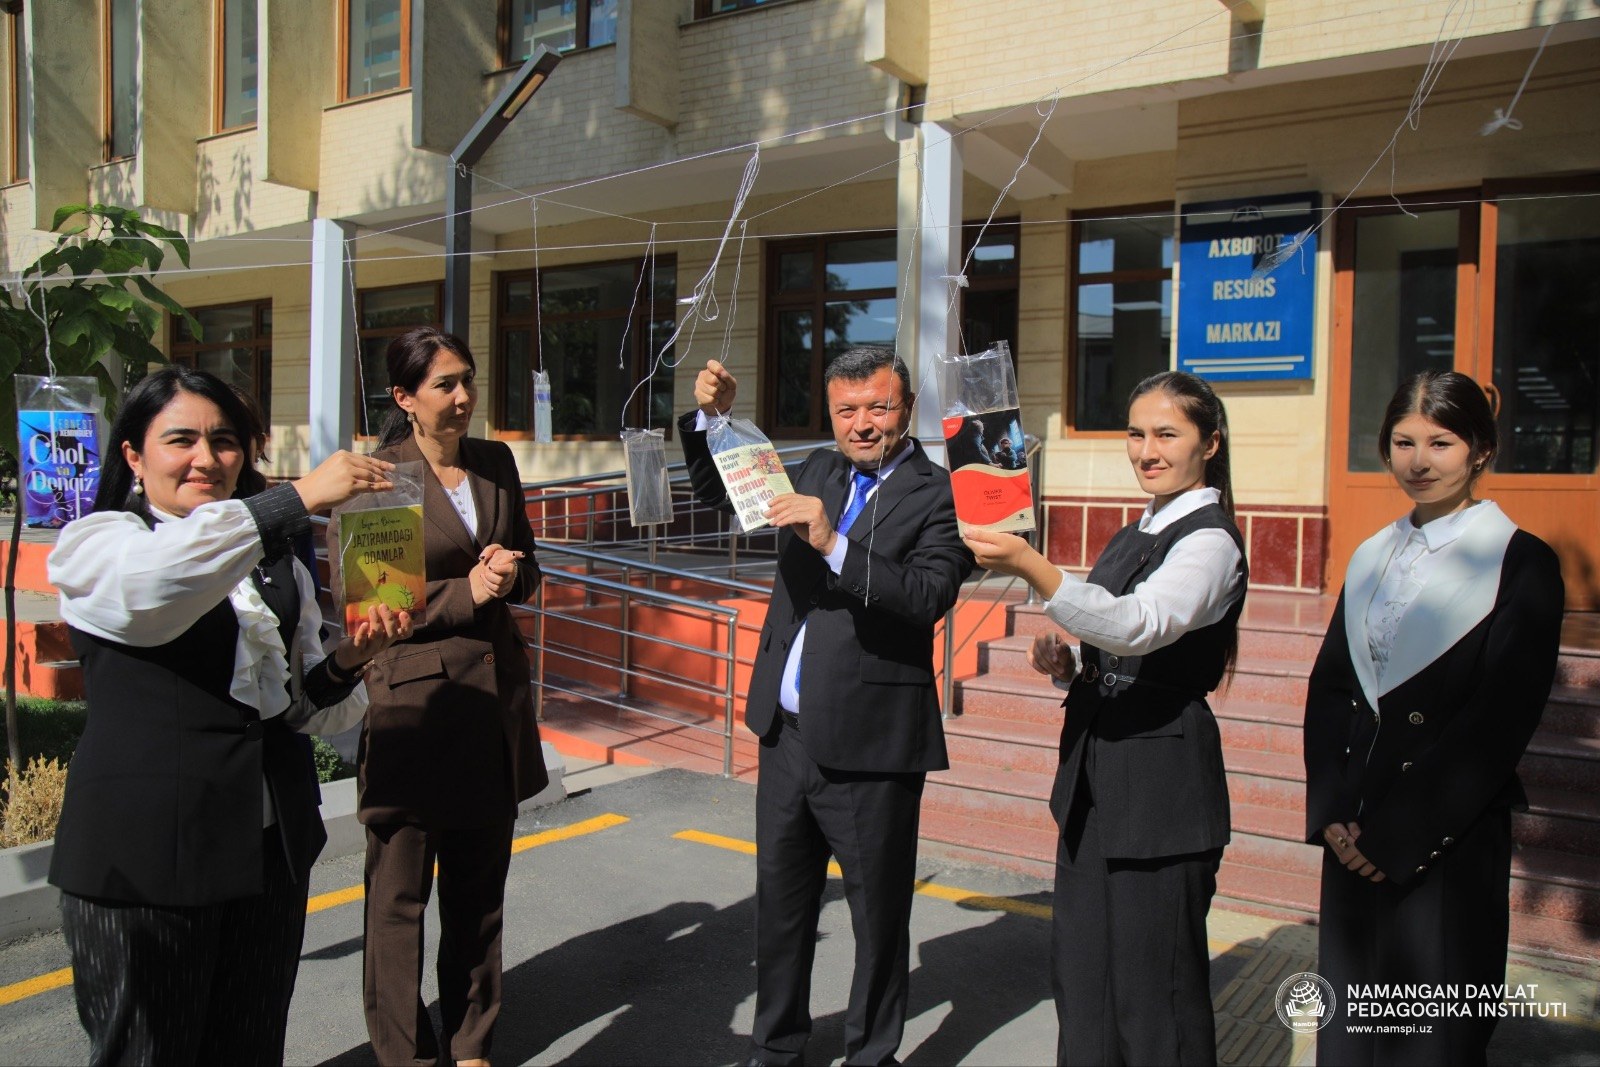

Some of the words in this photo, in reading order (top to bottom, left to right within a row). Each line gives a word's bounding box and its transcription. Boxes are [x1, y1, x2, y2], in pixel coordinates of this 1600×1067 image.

[1208, 234, 1285, 258] AXBOROT
[1212, 277, 1277, 300] RESURS
[1206, 321, 1282, 344] MARKAZI
[726, 467, 752, 484] Amir
[731, 477, 767, 497] Temur
[736, 489, 775, 511] haqida
[352, 529, 413, 548] JAZIRAMADAGI
[364, 547, 404, 564] ODAMLAR
